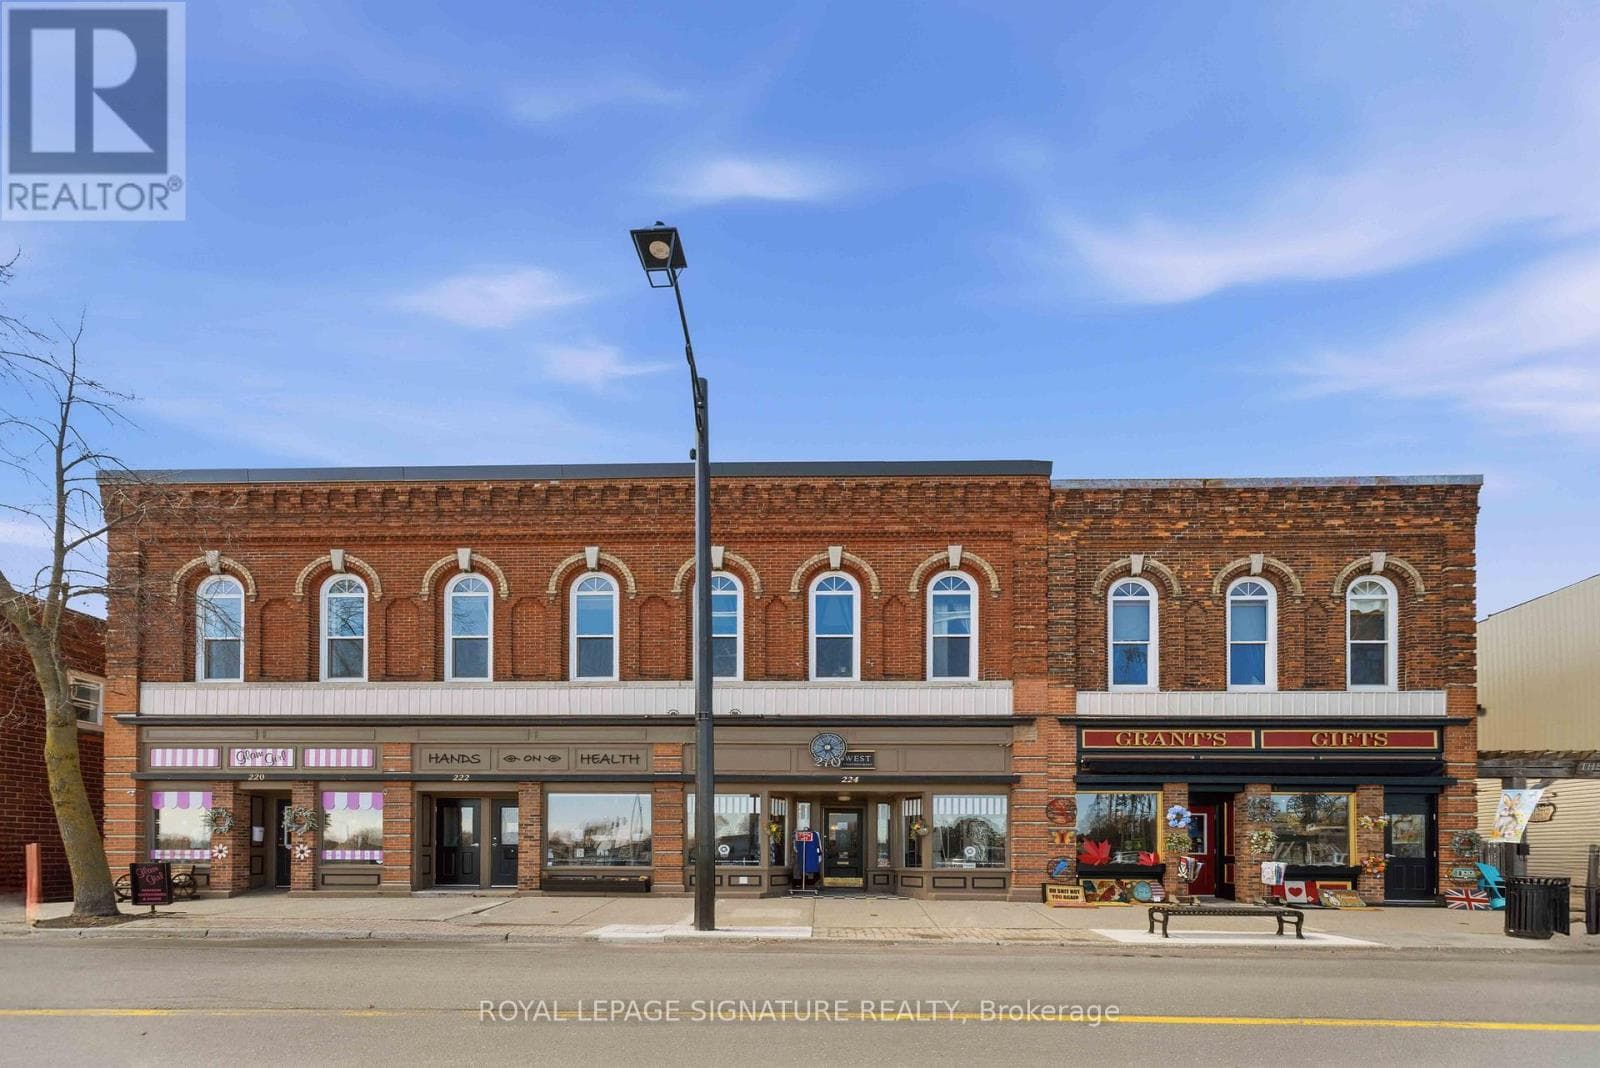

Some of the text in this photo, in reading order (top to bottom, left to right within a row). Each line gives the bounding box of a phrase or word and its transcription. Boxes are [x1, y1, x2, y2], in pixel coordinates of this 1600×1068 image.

[1115, 731, 1389, 747] GRANT'S GIFTS
[236, 750, 287, 766] Glam Girl
[428, 753, 640, 765] HANDS ON HEALTH
